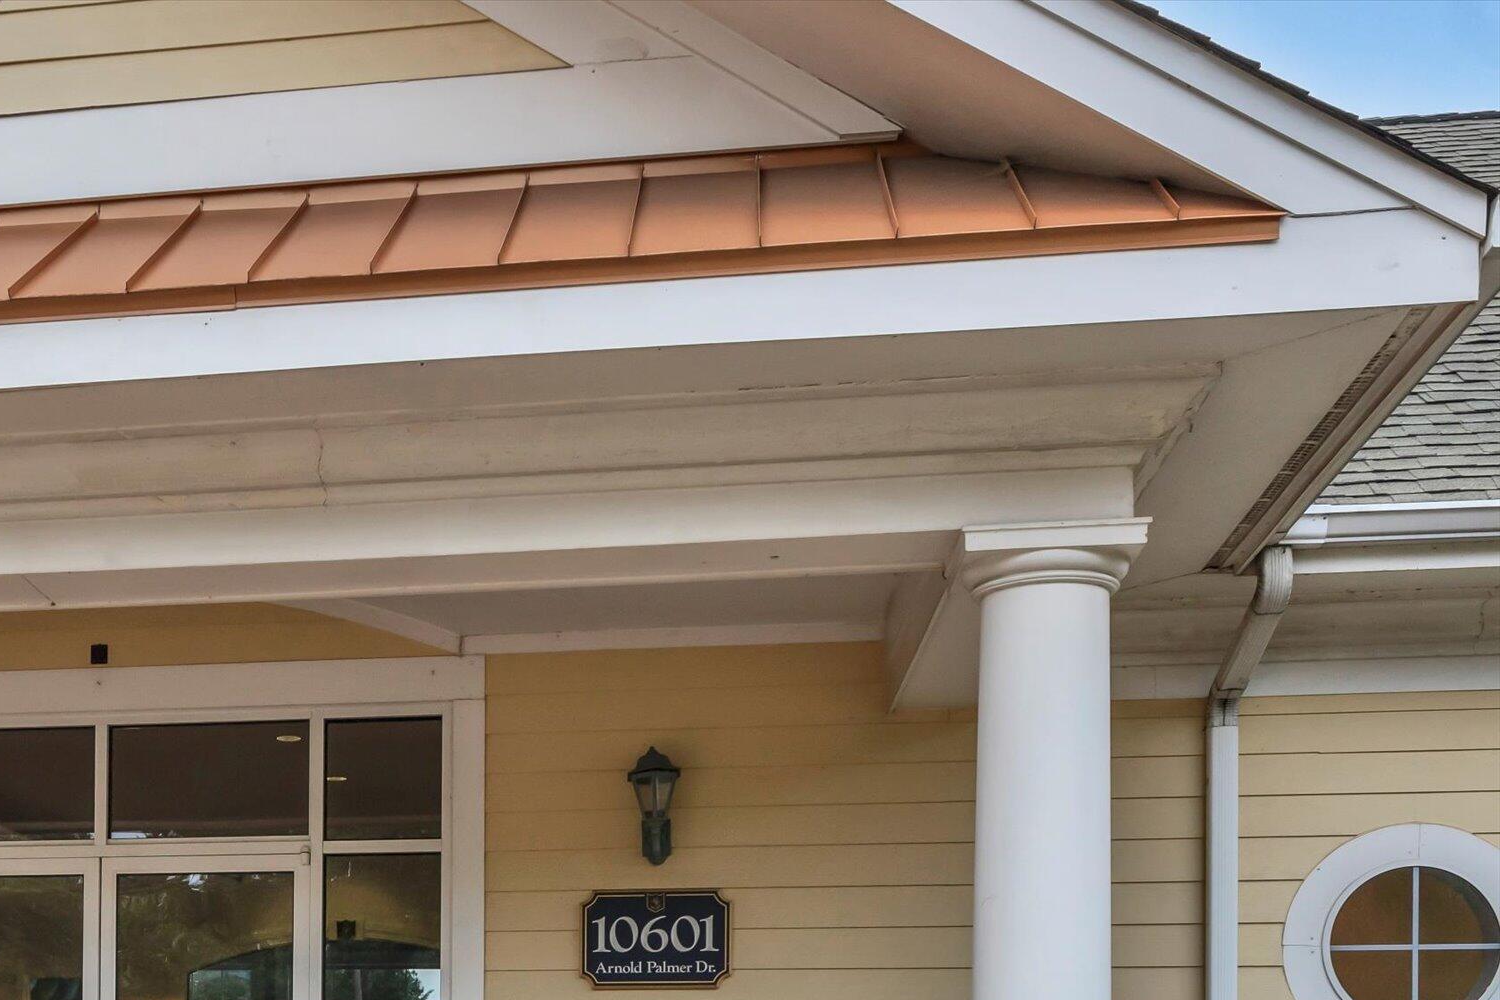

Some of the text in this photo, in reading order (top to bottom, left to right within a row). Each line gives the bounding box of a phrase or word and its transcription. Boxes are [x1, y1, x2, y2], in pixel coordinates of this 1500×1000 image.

[591, 914, 720, 953] 10601
[595, 960, 717, 974] Arnold Palmer Dr.
